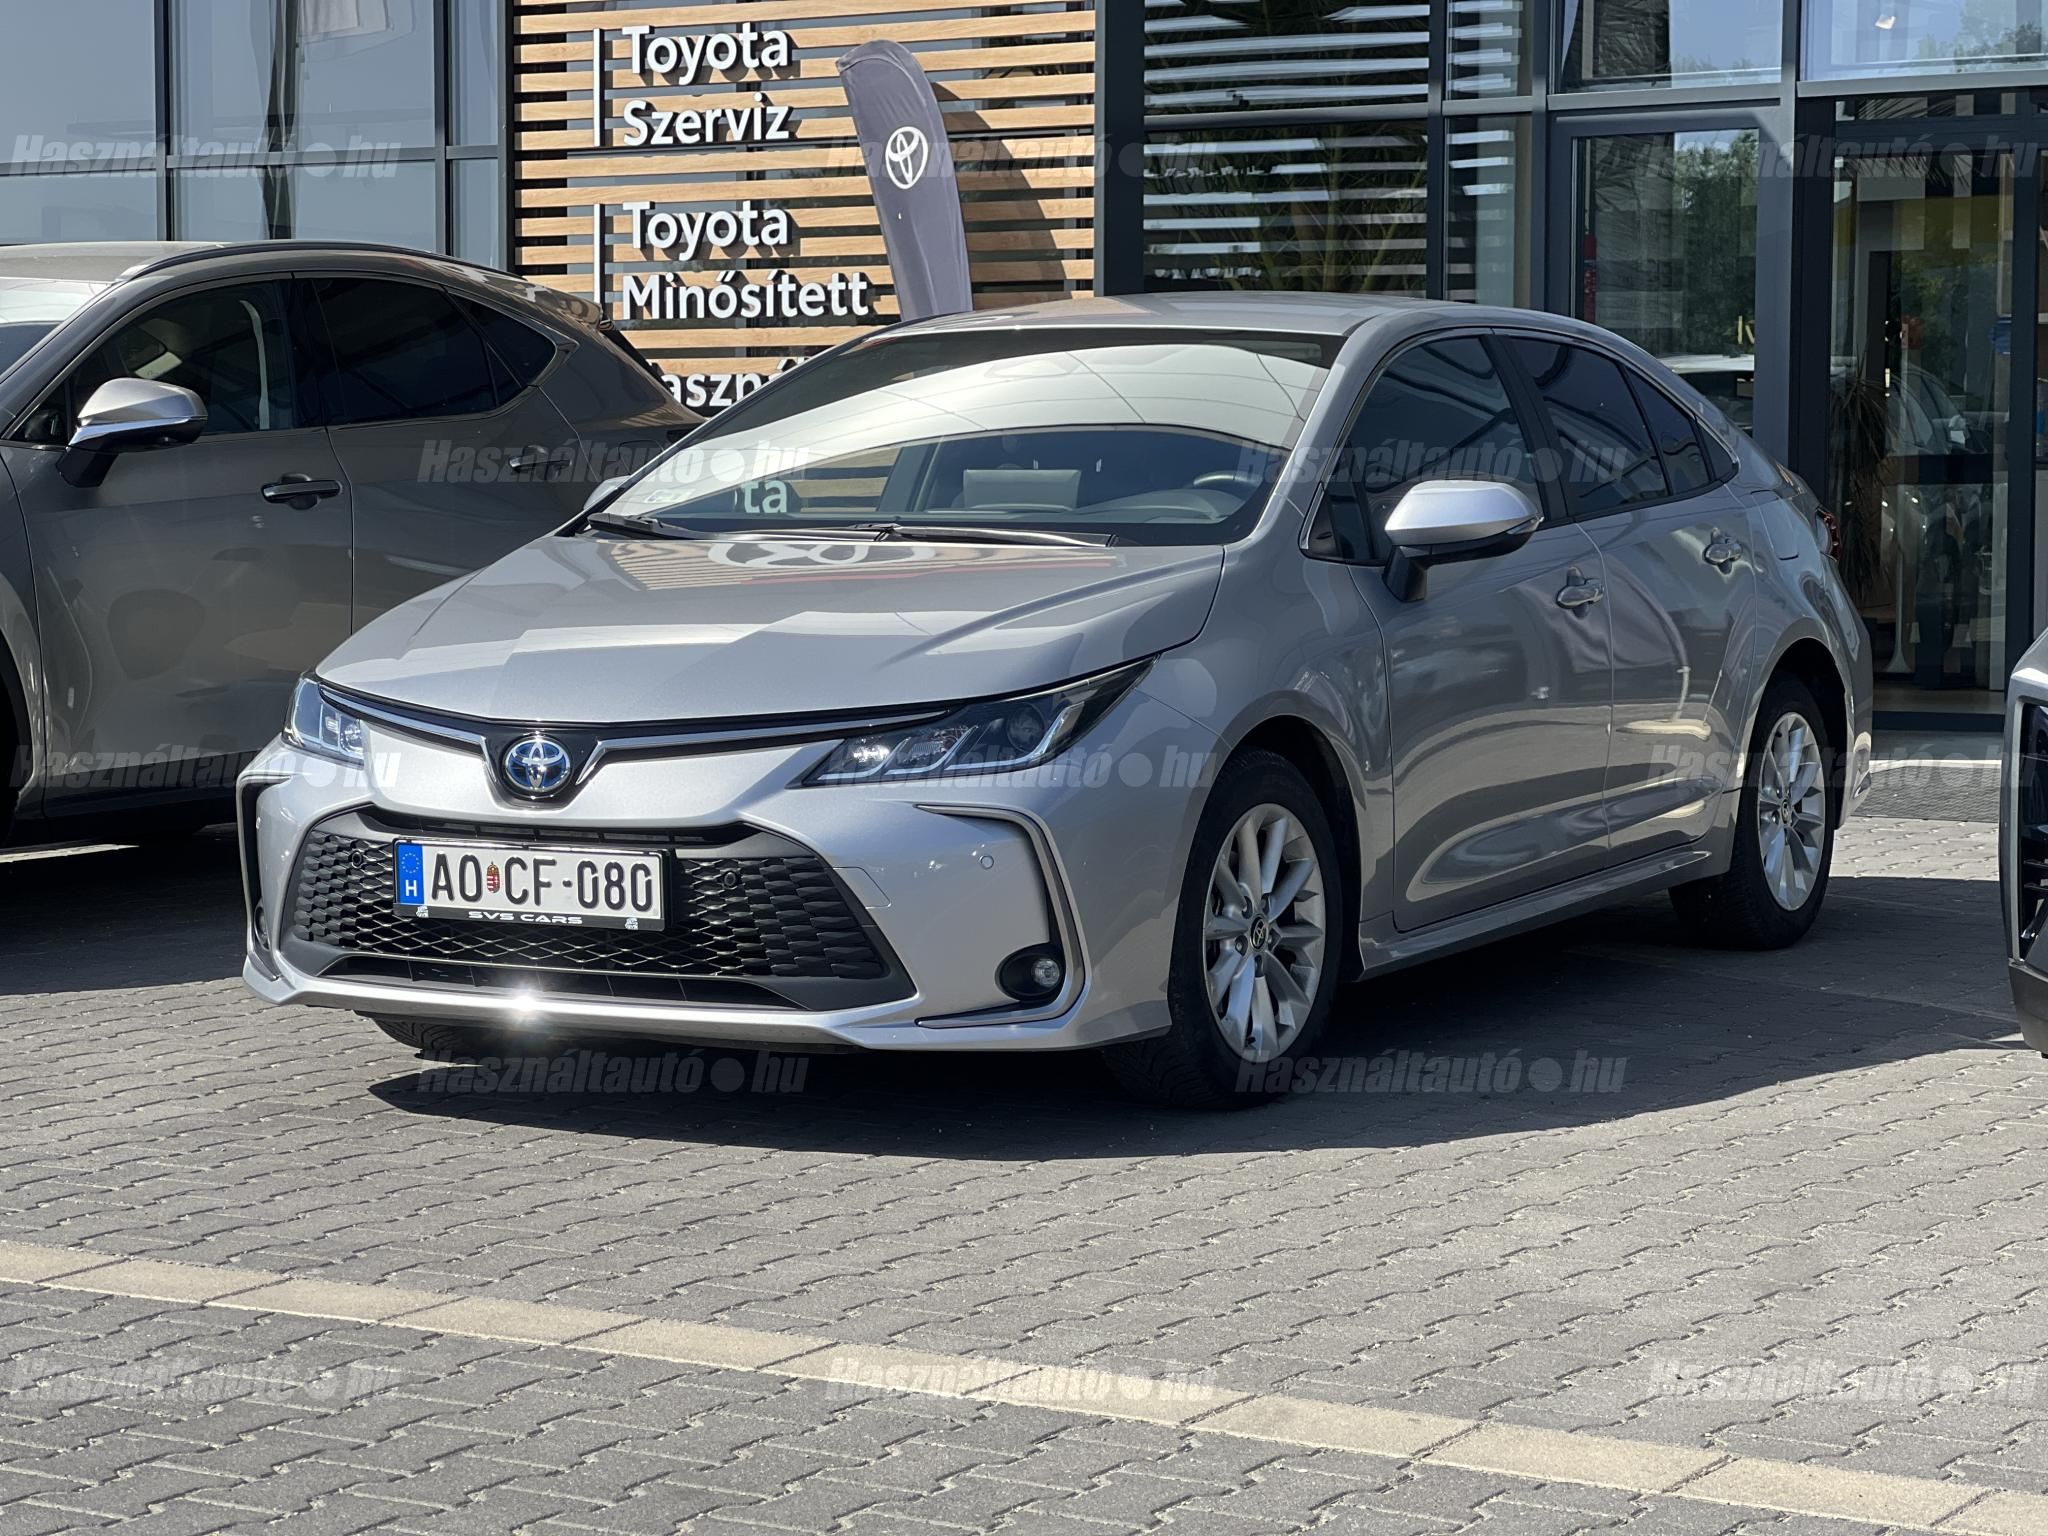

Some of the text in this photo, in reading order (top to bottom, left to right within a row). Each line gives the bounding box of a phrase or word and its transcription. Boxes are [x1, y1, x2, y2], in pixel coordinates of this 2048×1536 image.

[622, 23, 789, 85] Toyota
[623, 92, 790, 146] Szerviz
[622, 200, 789, 261] Toyota
[622, 269, 869, 319] Minősített
[649, 357, 806, 407] aszn
[734, 479, 788, 514] ta
[405, 879, 417, 897] H
[468, 911, 583, 924] SVS CARS
